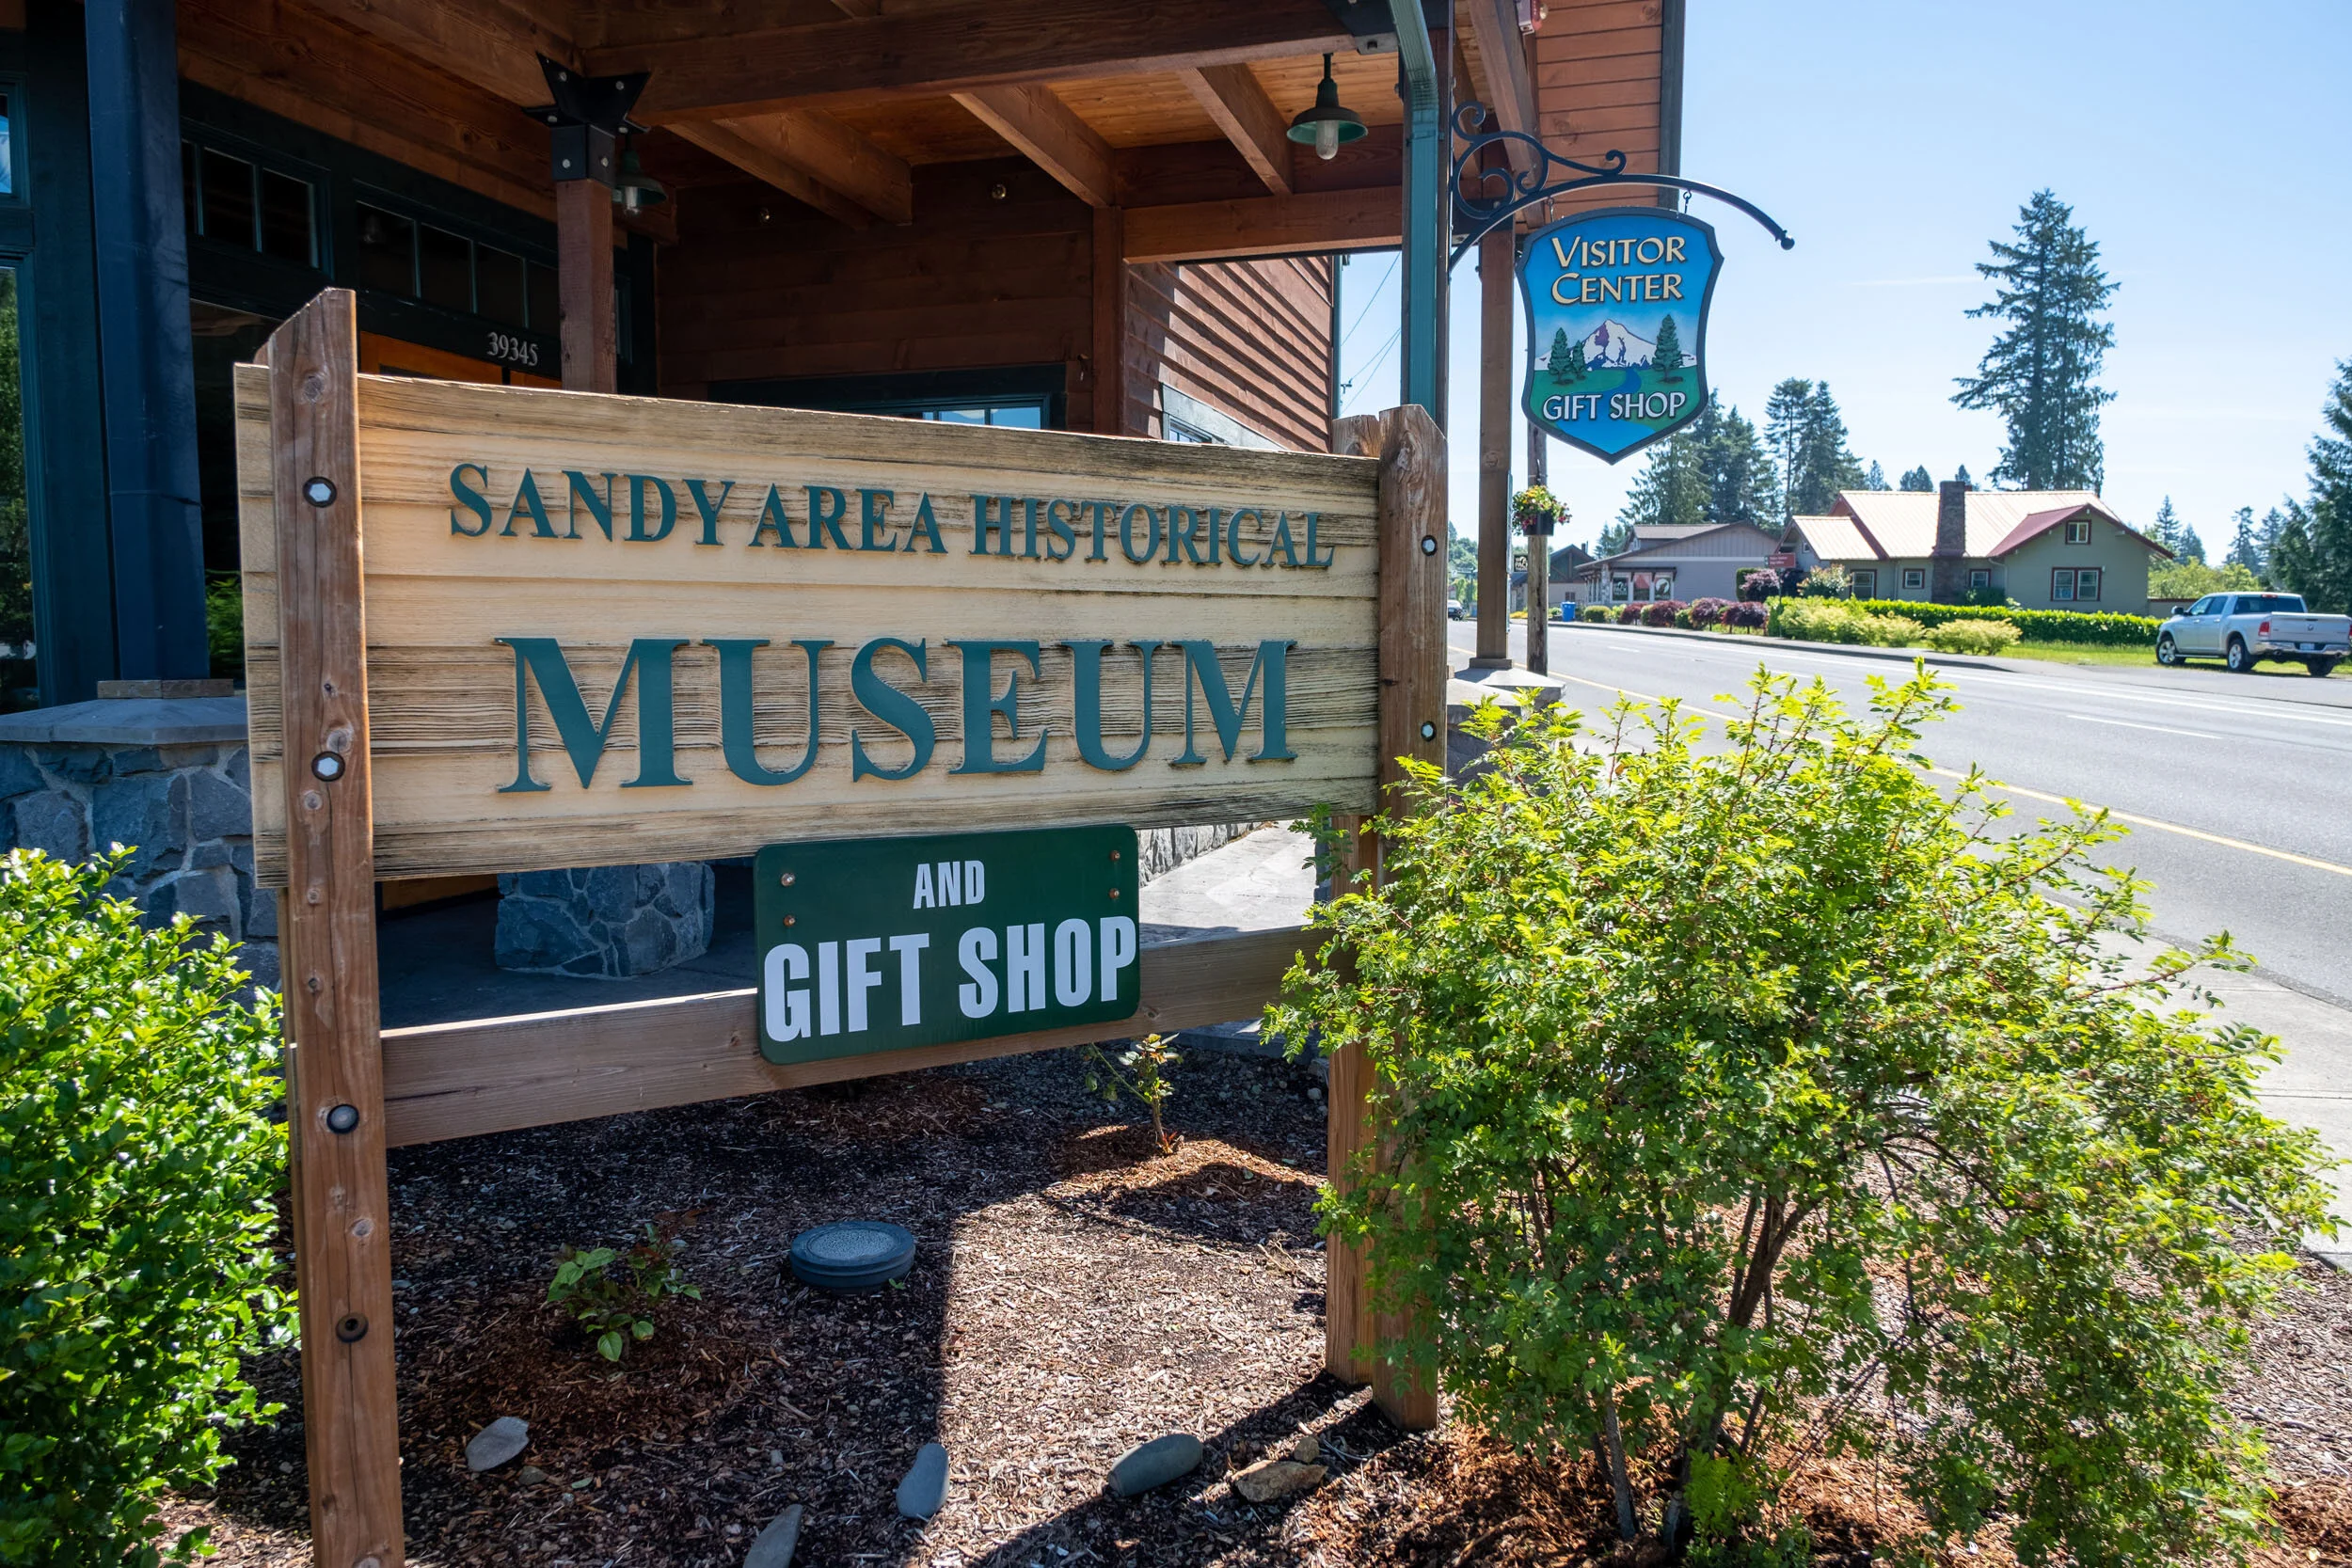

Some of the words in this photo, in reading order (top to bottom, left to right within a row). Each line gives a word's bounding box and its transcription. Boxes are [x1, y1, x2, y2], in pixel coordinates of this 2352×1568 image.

[1551, 236, 1686, 267] VISITOR
[1551, 272, 1682, 304] CENTER
[487, 332, 538, 366] 39345
[1543, 394, 1601, 420] GIFT
[1610, 392, 1686, 419] SHOP
[450, 463, 736, 546] SANDY
[749, 483, 948, 552] AREA
[968, 493, 1336, 566] HISTORICAL
[494, 637, 1298, 793] MUSEUM
[913, 860, 985, 910] AND
[764, 932, 930, 1042] GIFT
[959, 915, 1136, 1019] SHOP
